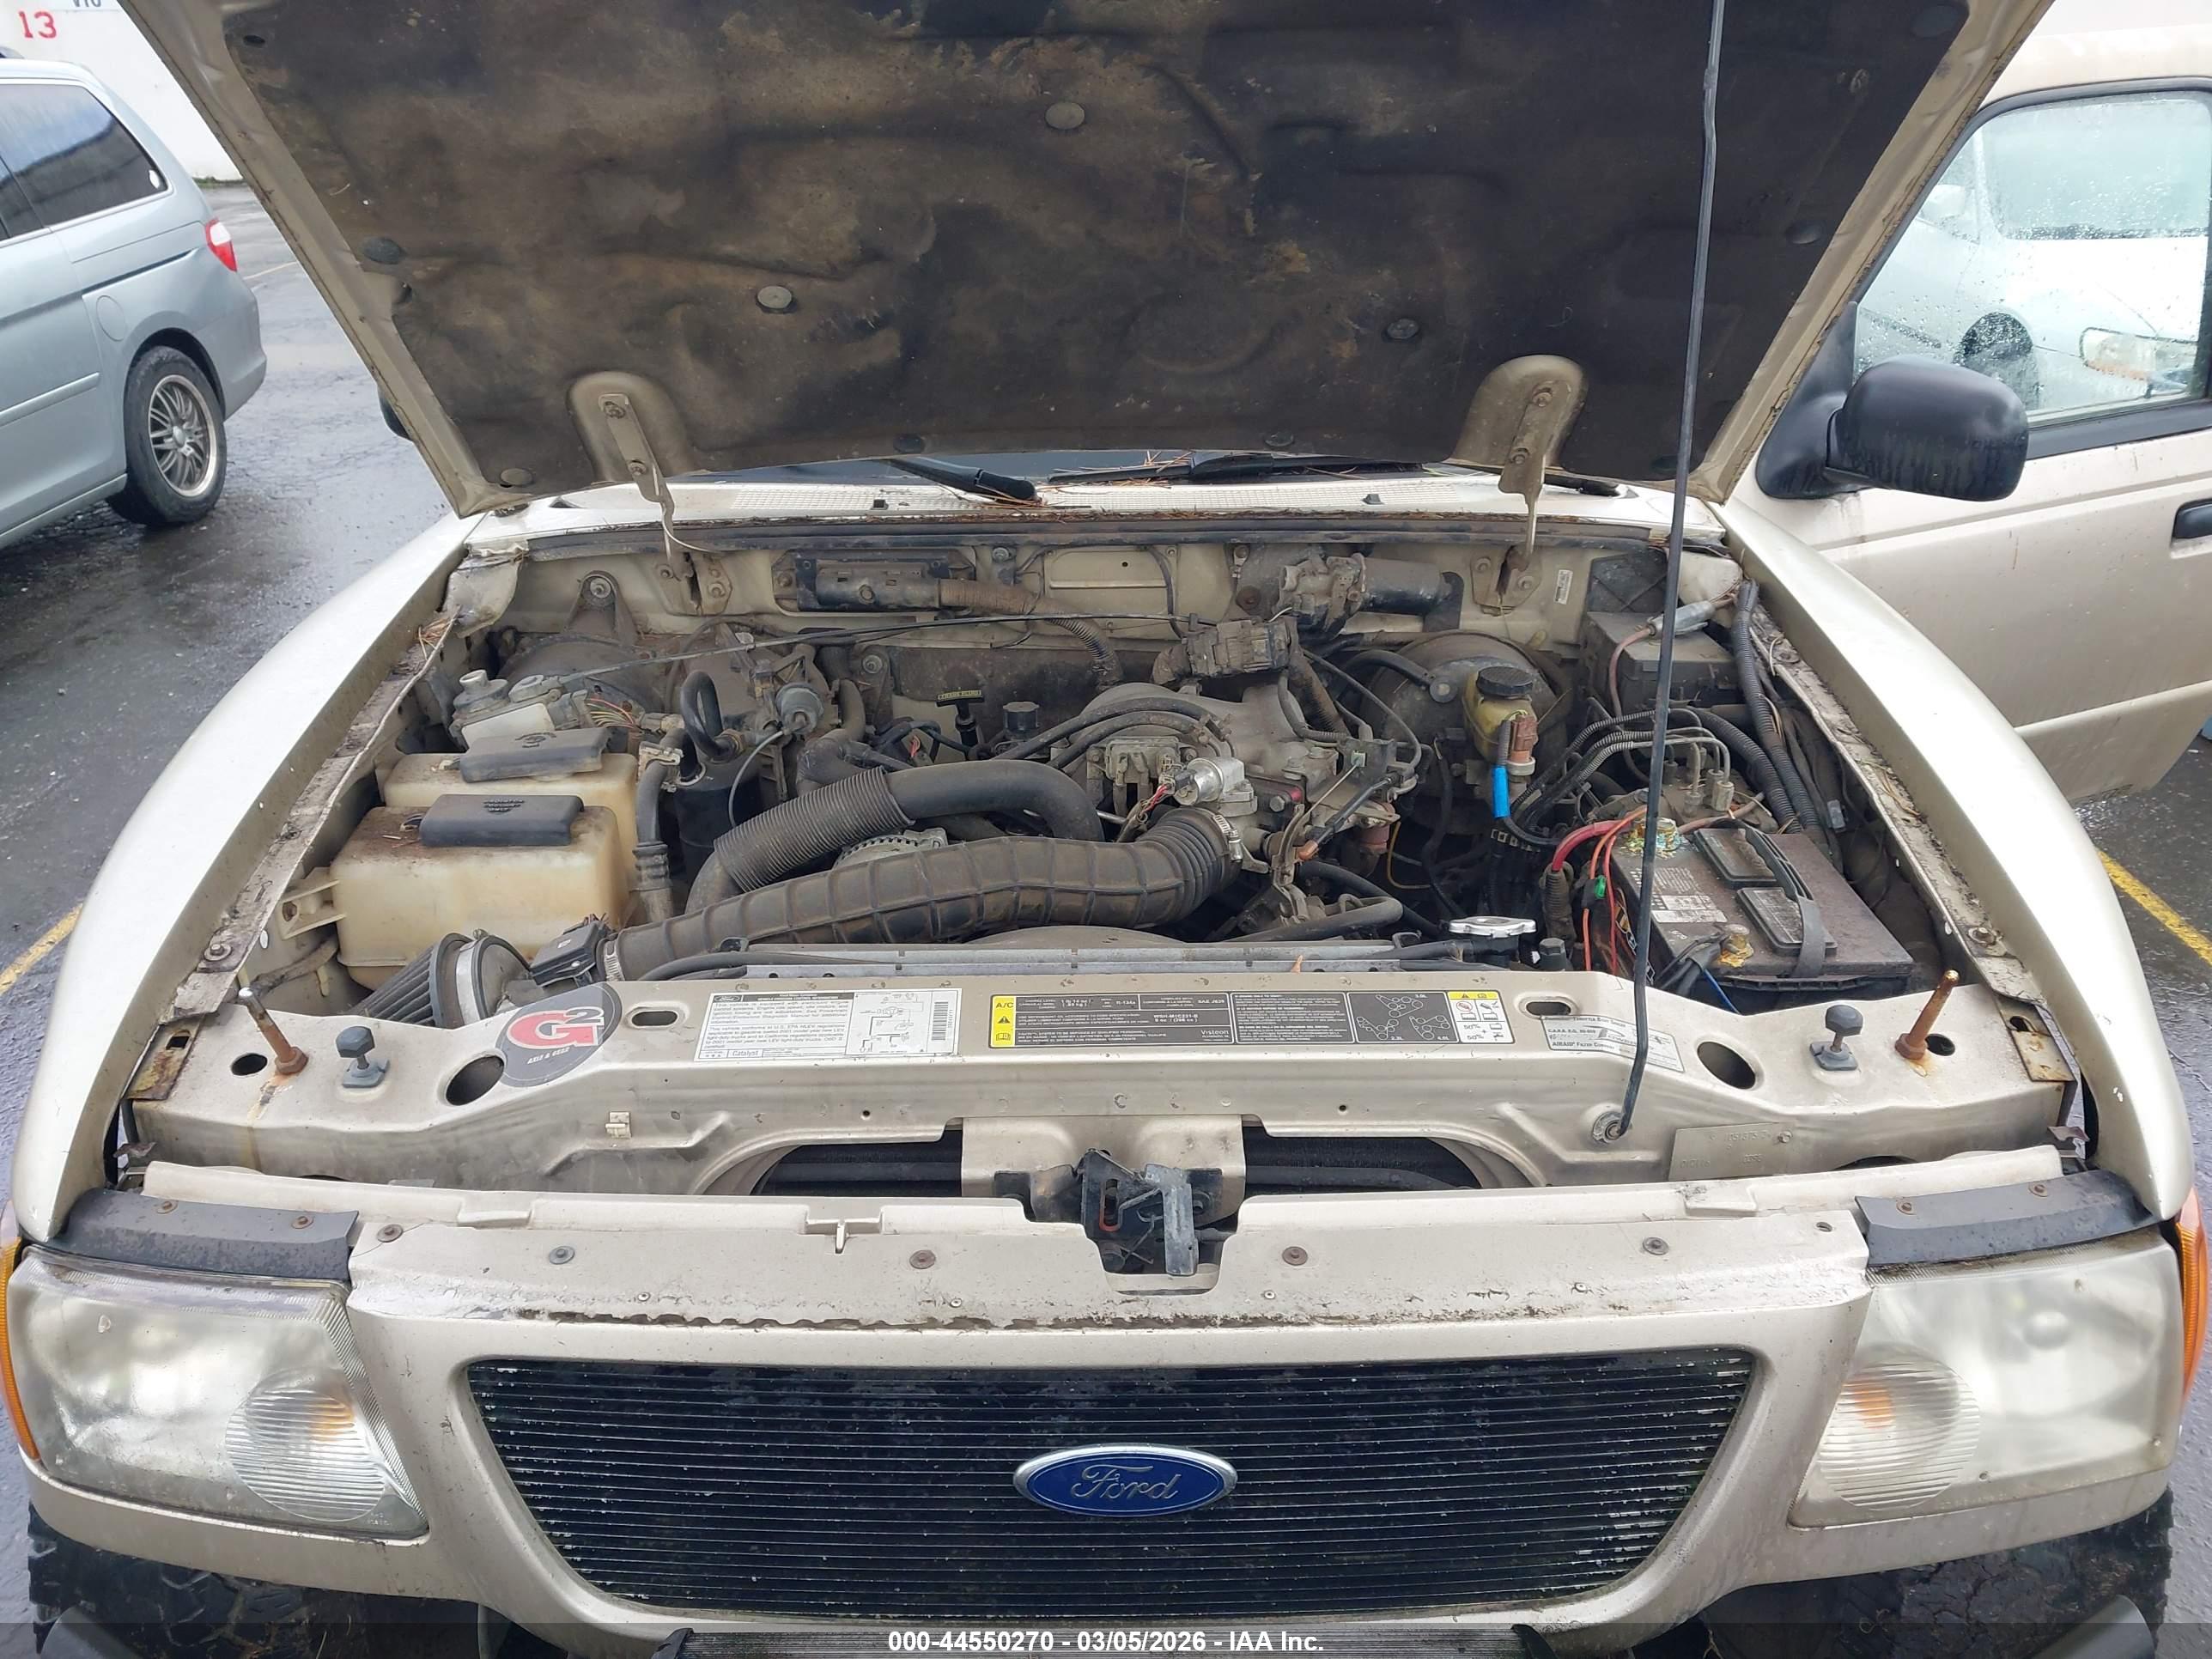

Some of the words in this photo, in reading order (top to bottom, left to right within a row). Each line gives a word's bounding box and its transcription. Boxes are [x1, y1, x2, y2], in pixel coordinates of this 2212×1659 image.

[18, 11, 57, 39] 13
[507, 1006, 605, 1049] G2
[1071, 1464, 1182, 1499] Ford
